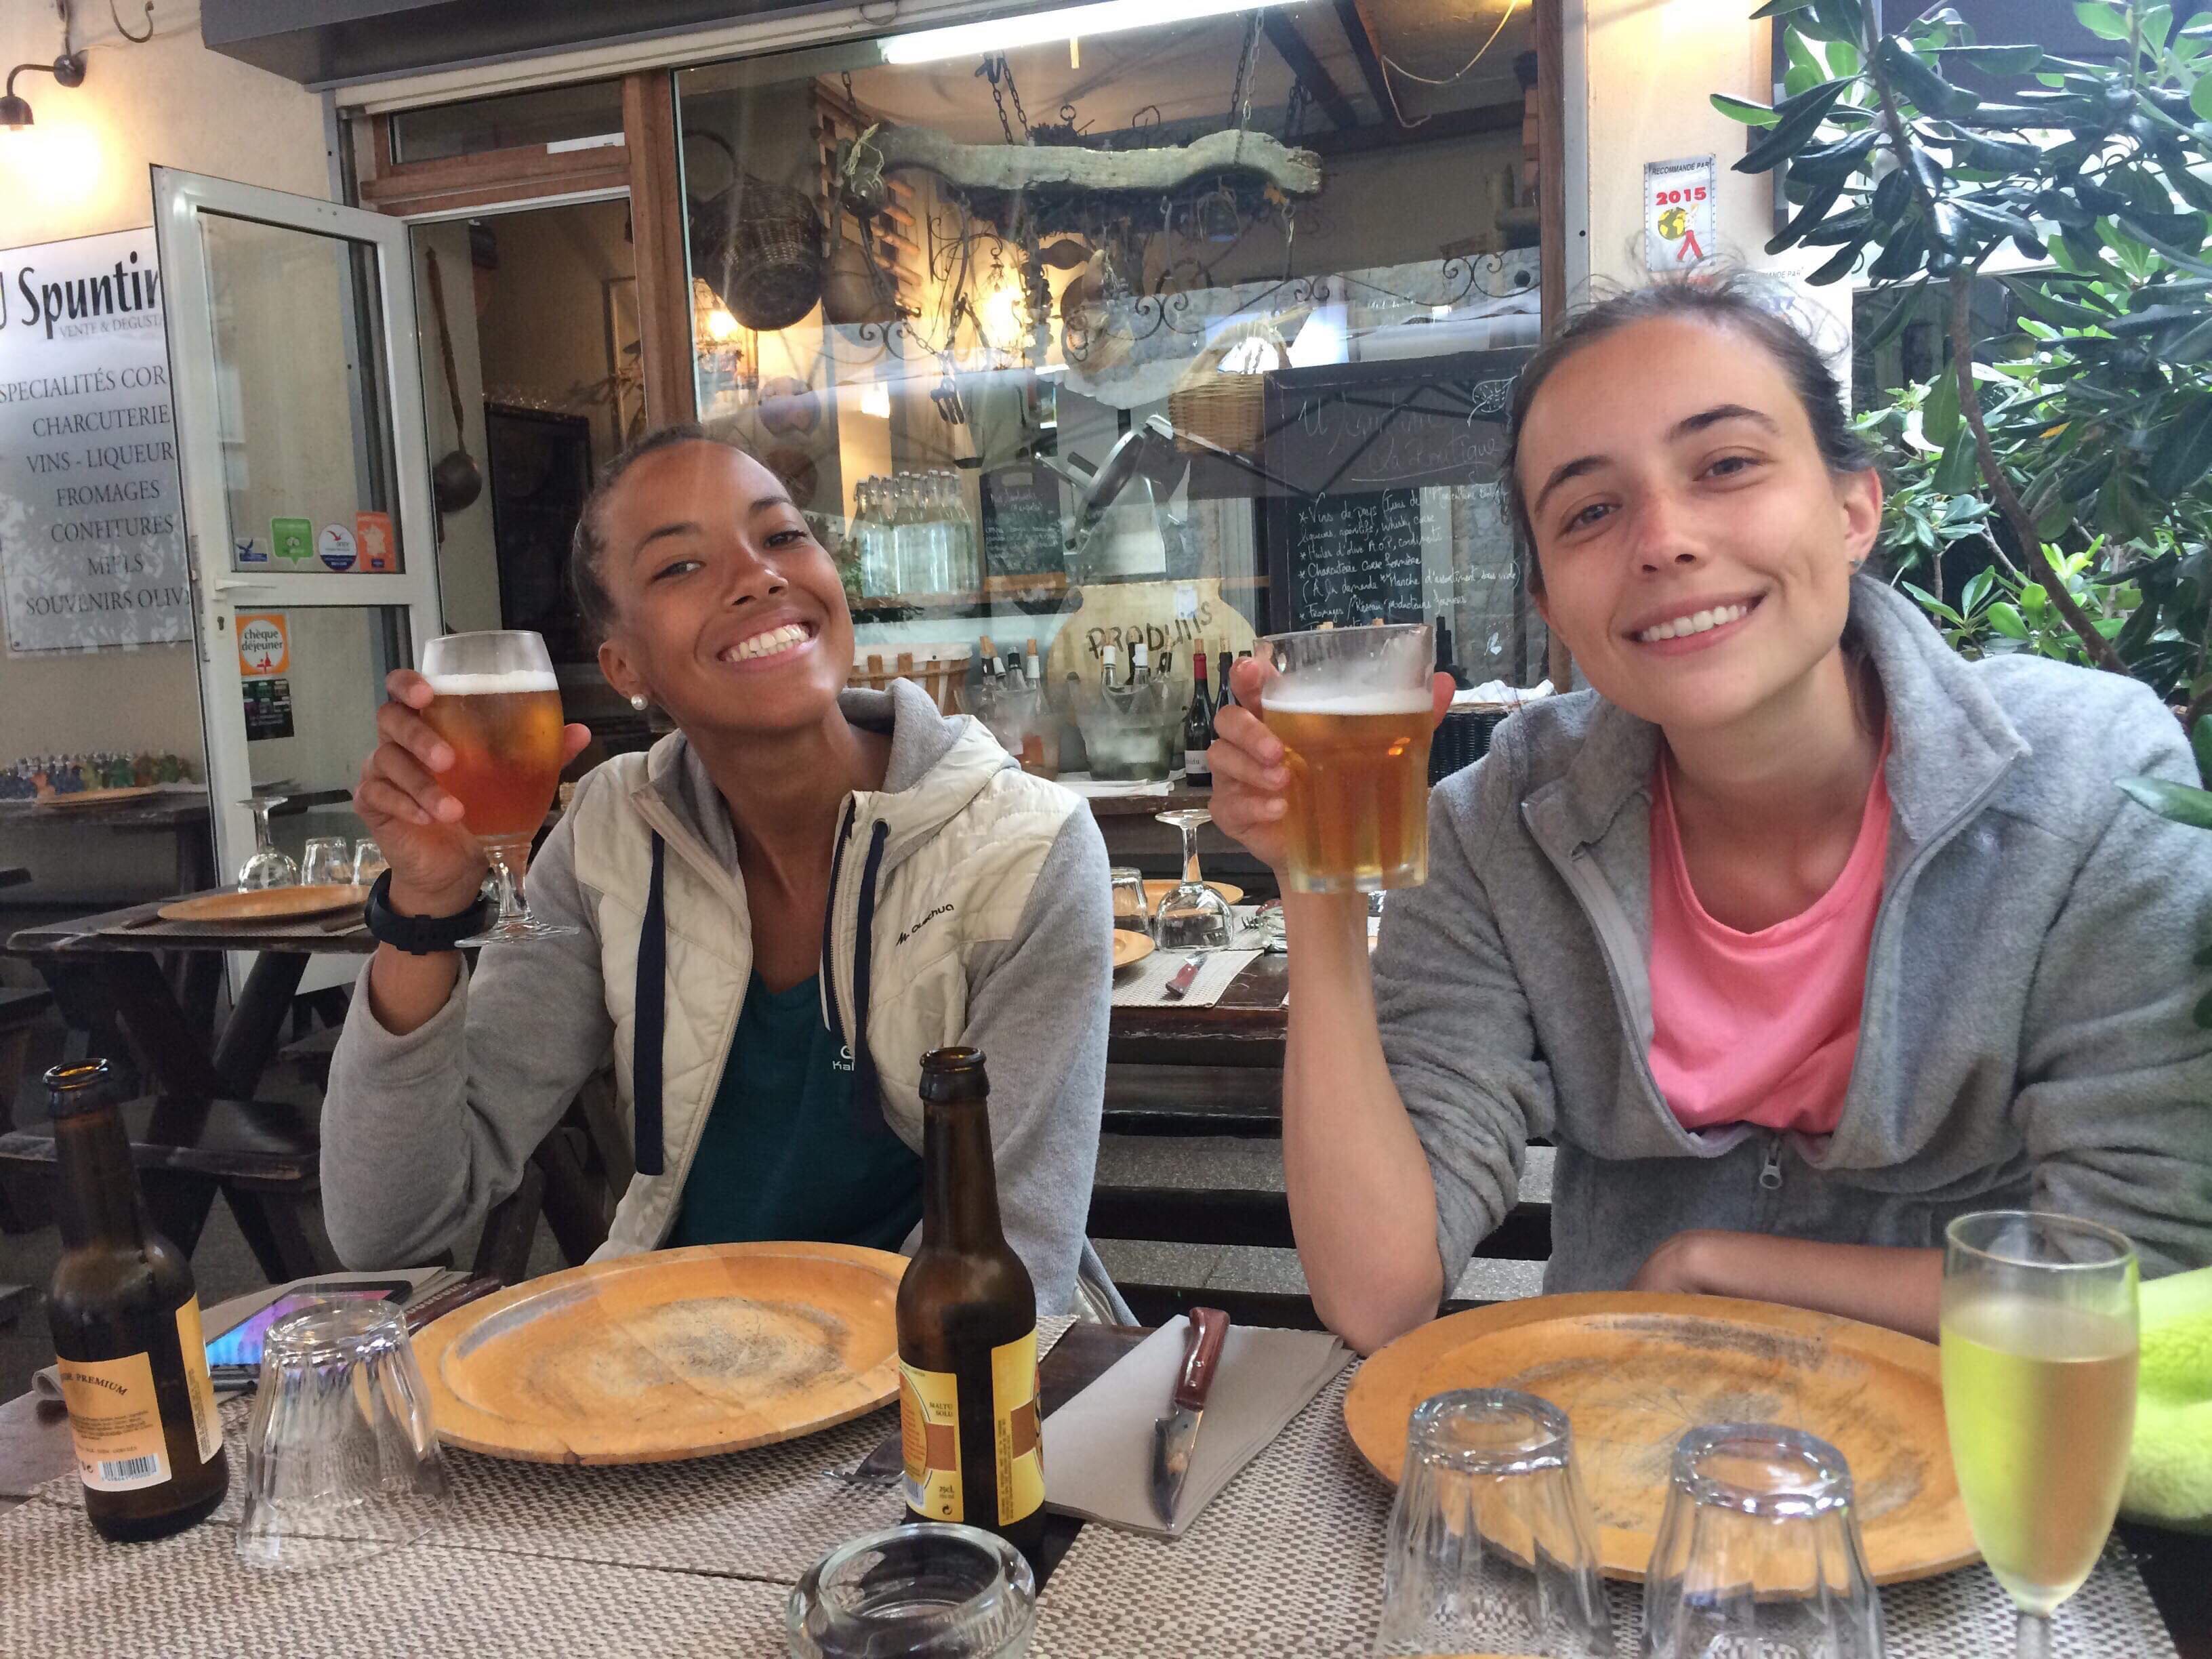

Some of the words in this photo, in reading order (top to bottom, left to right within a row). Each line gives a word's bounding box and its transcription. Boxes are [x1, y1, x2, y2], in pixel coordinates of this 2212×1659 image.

[1696, 161, 1710, 169] PAR
[1656, 187, 1706, 205] 2015
[59, 322, 97, 337] VENTE
[102, 321, 110, 332] &
[0, 367, 116, 403] SPECIALITÉS
[121, 365, 167, 388] COR
[33, 405, 171, 436] CHARCUTERIE
[27, 451, 70, 473] VINS
[87, 442, 175, 471] LIQUEUR
[57, 480, 161, 506] FROMAGES
[1341, 500, 1351, 519] de
[1353, 506, 1377, 526] pays
[1410, 489, 1420, 507] de
[51, 514, 174, 543] CONFITURES
[1381, 515, 1414, 533] whisky
[1308, 562, 1358, 578] Charcuterie
[1343, 575, 1378, 594] demande
[26, 589, 132, 615] SOUVENIRS
[1305, 602, 1345, 623] Fromages
[245, 629, 279, 640] chèque
[241, 640, 283, 653] déjeuner
[76, 1373, 128, 1396] PREMIUM
